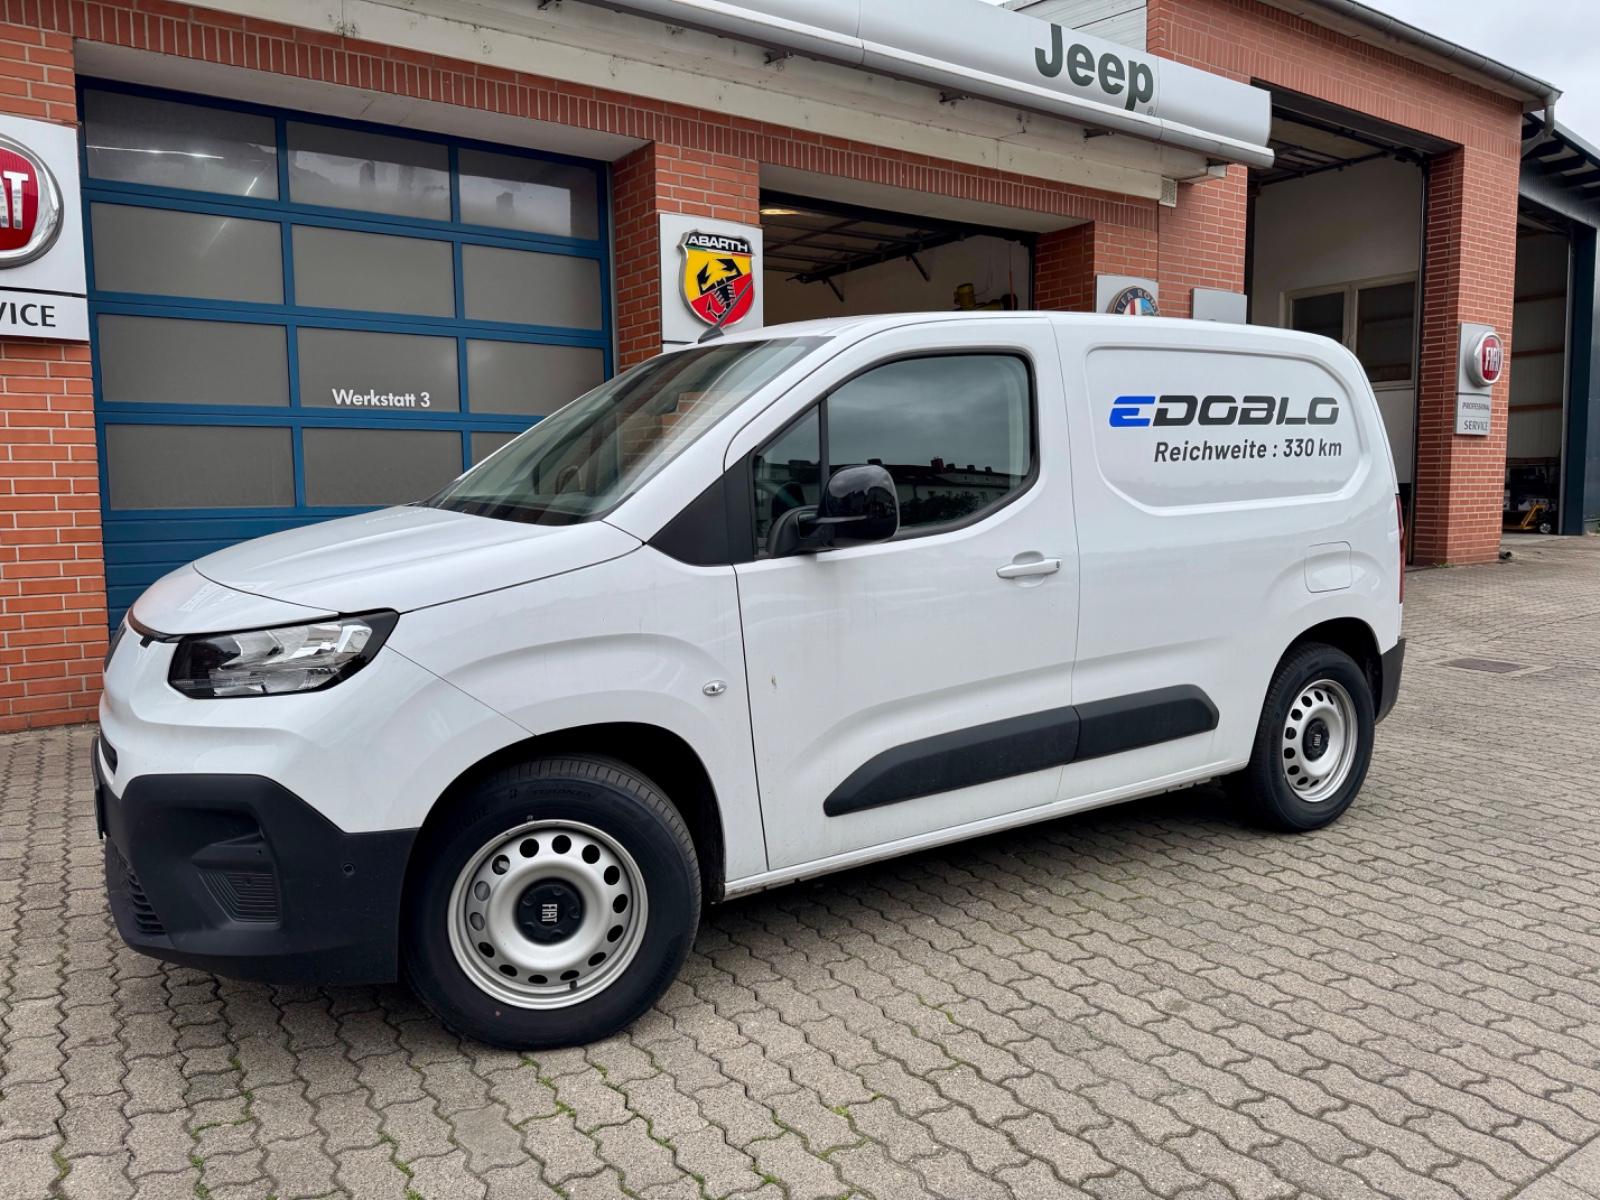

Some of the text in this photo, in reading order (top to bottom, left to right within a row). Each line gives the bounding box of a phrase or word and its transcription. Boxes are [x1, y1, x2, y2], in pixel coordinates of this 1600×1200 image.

[1035, 23, 1154, 112] Jeep
[688, 235, 748, 252] ABARTH
[332, 388, 431, 408] Werkstatt 3
[1154, 439, 1267, 463] Reichweite
[1283, 438, 1316, 457] 330
[1318, 438, 1342, 457] km
[541, 903, 558, 923] FIAT
